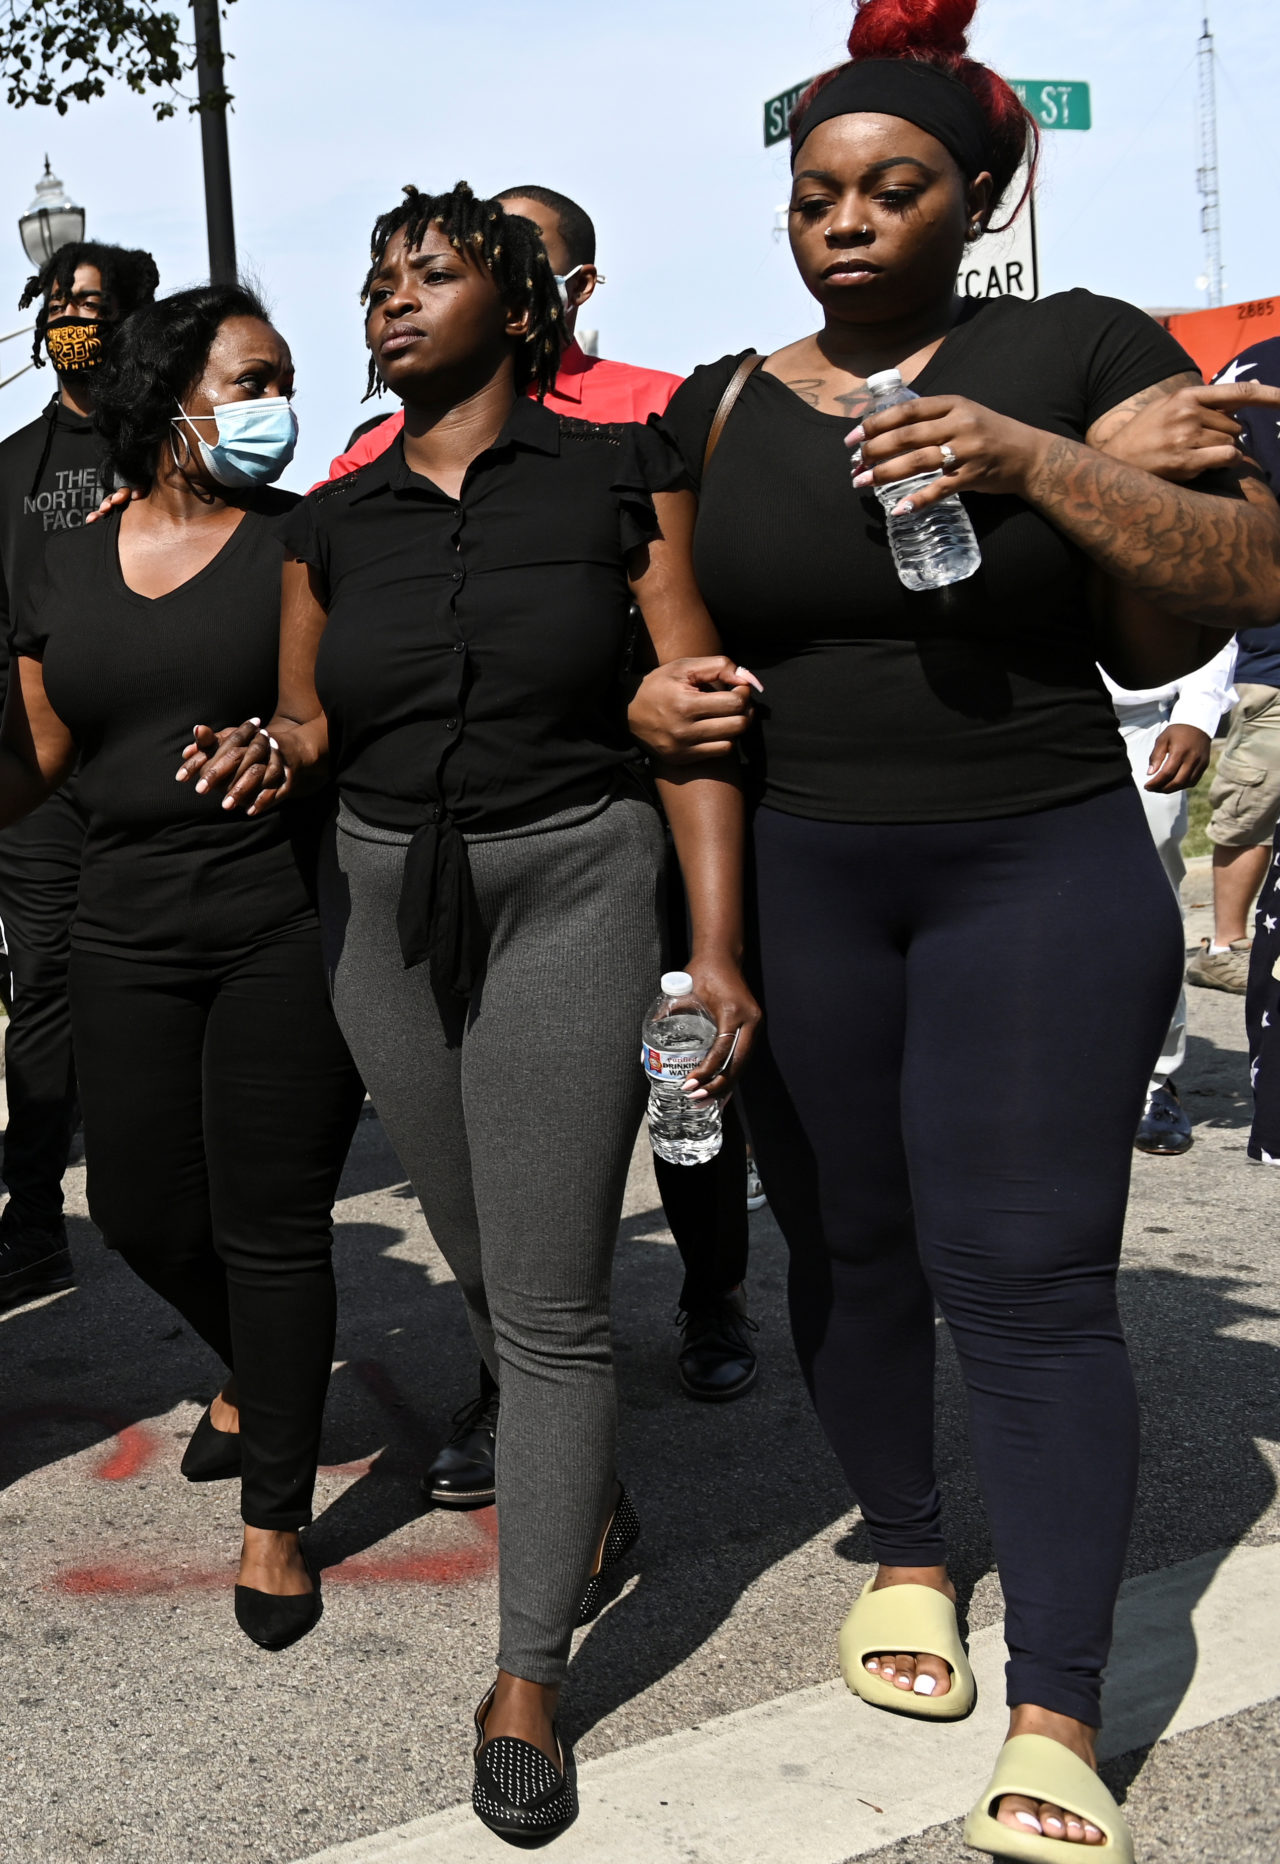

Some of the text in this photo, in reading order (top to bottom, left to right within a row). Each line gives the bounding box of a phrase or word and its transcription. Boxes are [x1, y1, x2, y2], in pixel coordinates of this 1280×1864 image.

[1041, 85, 1072, 125] ST
[55, 468, 97, 490] THE
[23, 487, 96, 515] NORTH
